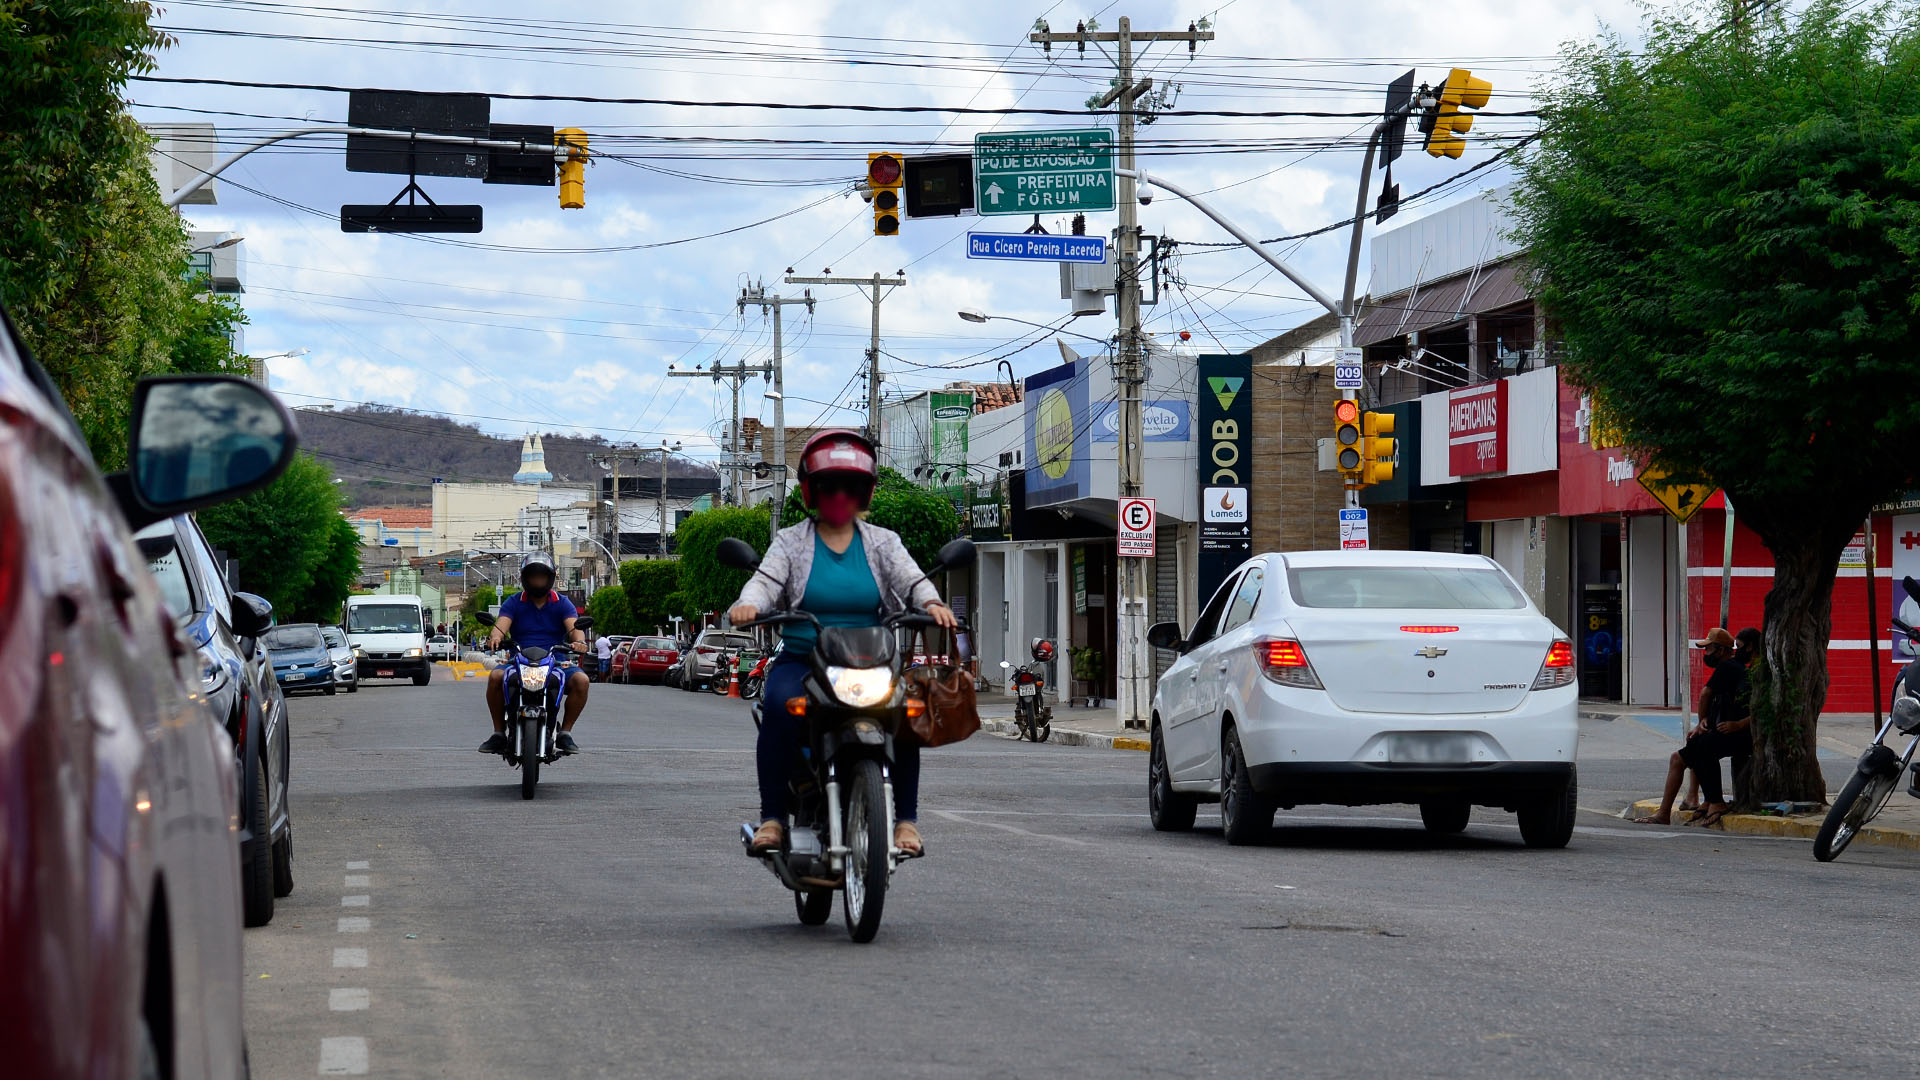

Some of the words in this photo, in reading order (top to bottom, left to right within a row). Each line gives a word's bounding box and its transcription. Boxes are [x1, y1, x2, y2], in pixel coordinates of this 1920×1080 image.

[1018, 135, 1081, 152] MUNICIPAL
[1023, 149, 1096, 168] EXPOSIÇÃO
[1017, 173, 1107, 189] PREFEITURA
[1017, 188, 1081, 206] FÓRUM
[972, 239, 990, 253] Rua
[994, 238, 1023, 254] Cícero
[1027, 241, 1060, 255] Pereira
[1064, 243, 1101, 257] Lacerda
[1337, 368, 1360, 378] 009
[1450, 397, 1497, 432] AMERICANAS
[1132, 508, 1143, 524] E
[1120, 531, 1153, 540] EXCLUSIVO
